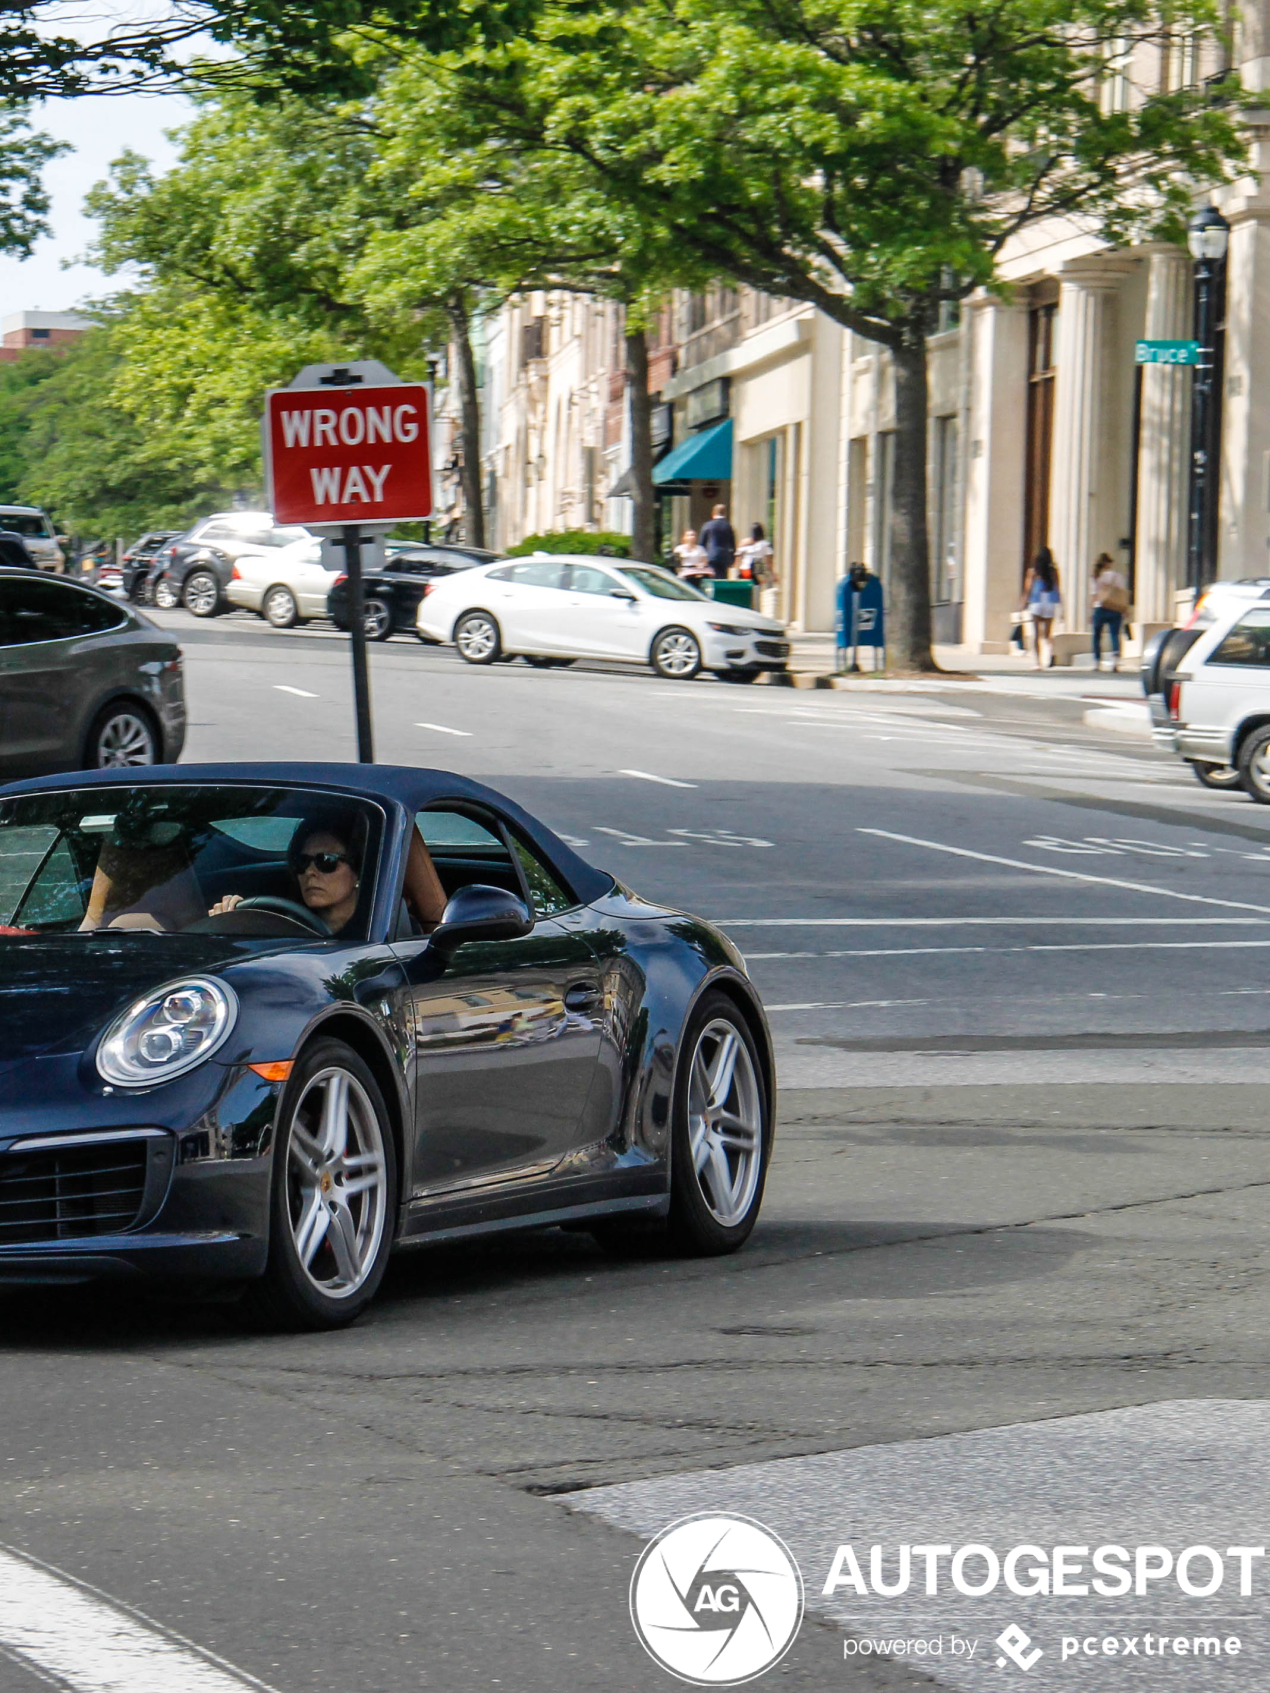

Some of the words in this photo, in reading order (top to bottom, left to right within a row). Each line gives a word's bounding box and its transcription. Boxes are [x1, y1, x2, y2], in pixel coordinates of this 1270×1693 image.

[1135, 343, 1189, 362] Bruce
[280, 404, 419, 448] WRONG
[310, 464, 392, 506] WAY
